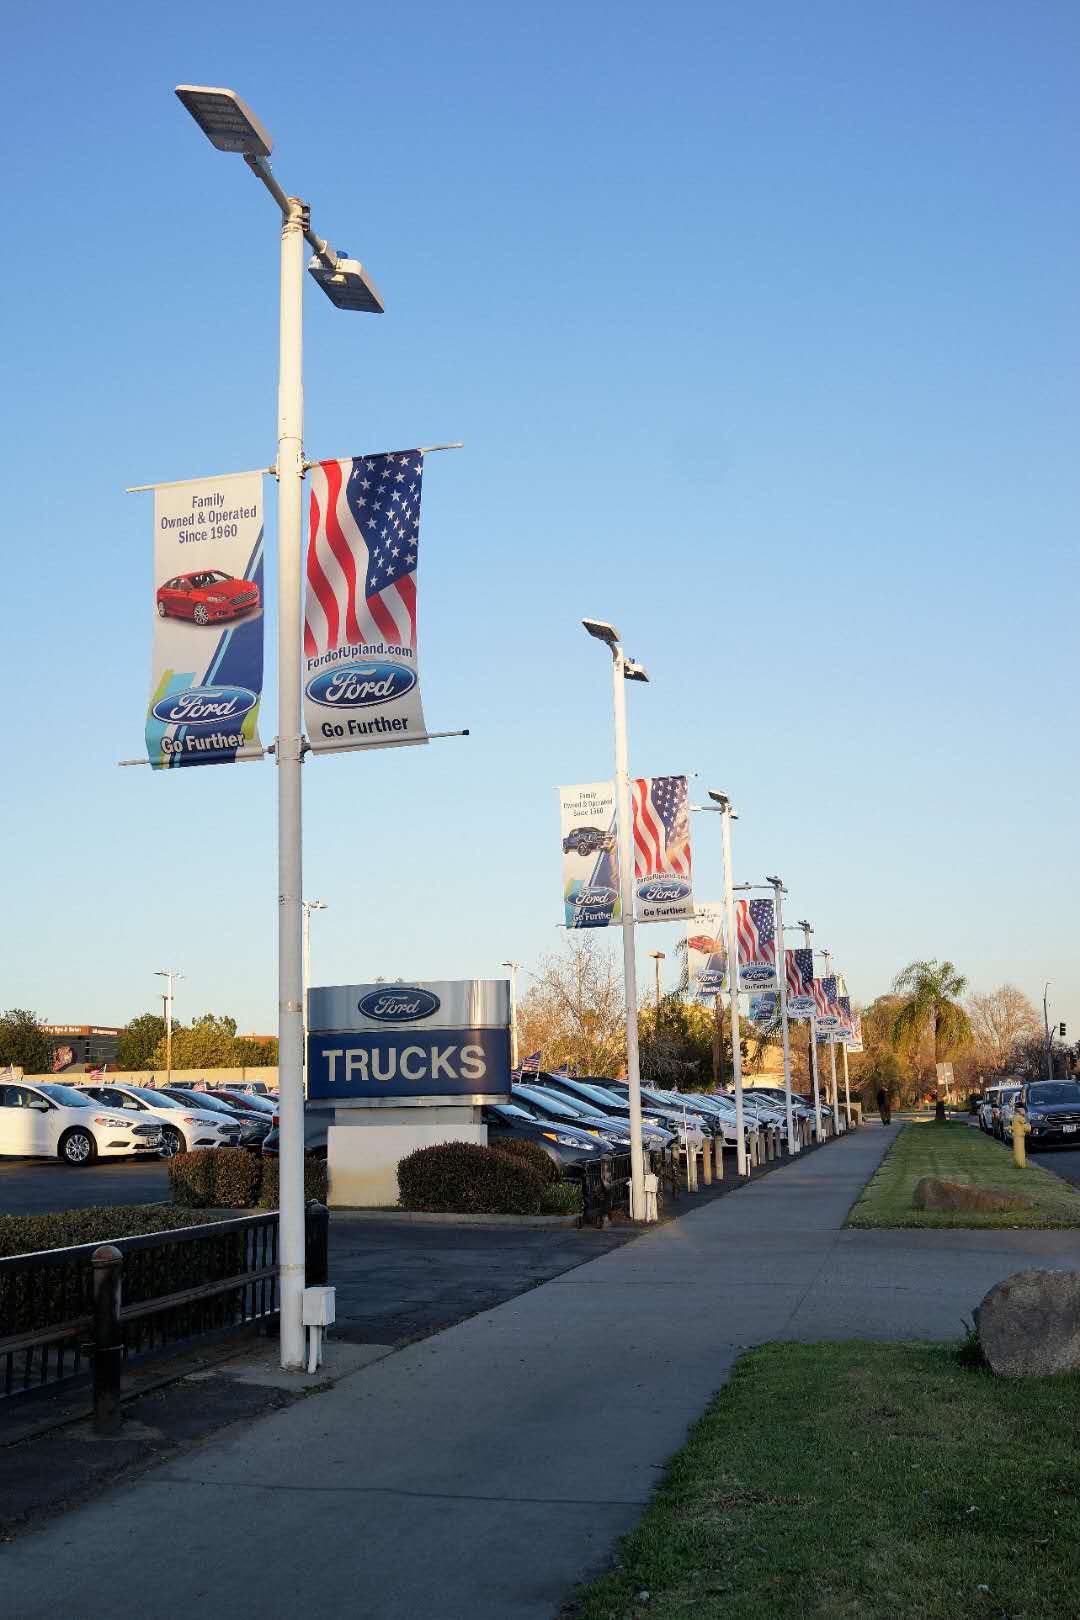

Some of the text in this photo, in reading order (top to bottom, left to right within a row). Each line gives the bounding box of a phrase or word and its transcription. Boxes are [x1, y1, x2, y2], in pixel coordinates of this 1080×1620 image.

[192, 493, 225, 508] Family
[161, 505, 257, 530] Owned & Operated
[178, 523, 238, 544] Since 1960
[307, 643, 413, 671] FordofUpland.com
[326, 669, 396, 702] Ford
[169, 690, 239, 719] Ford
[321, 716, 409, 738] Go Further
[160, 733, 245, 754] Go Further
[575, 889, 610, 905] Ford
[647, 884, 681, 900] Ford
[643, 908, 655, 916] Go
[656, 906, 687, 916] Further
[374, 996, 421, 1014] Ford
[322, 1045, 487, 1082] TRUCKS
